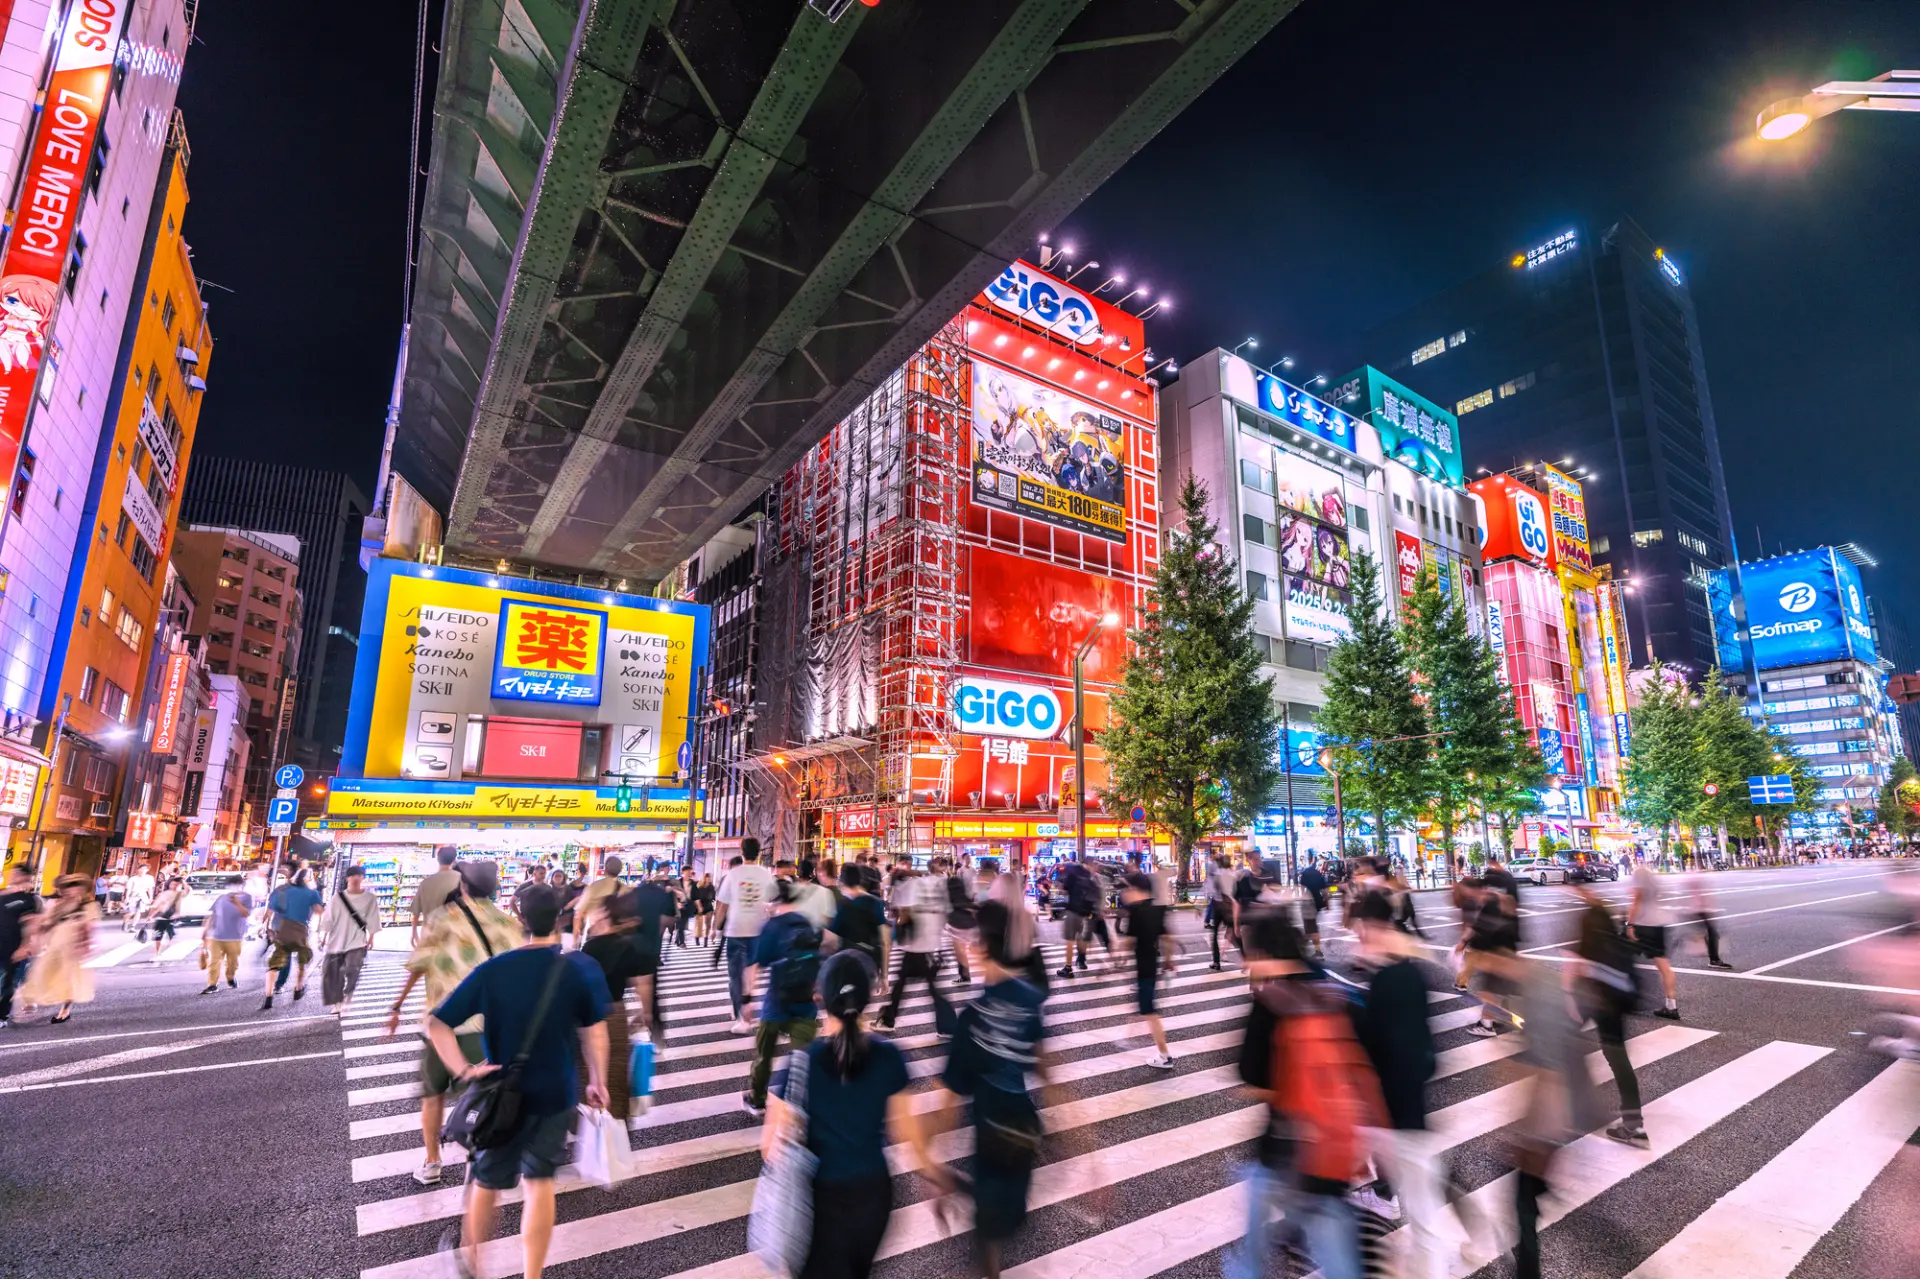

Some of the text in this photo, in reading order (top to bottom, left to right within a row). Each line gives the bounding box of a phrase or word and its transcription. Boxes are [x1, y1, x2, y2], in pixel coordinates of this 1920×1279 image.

[20, 88, 93, 258] LOVE MERCI
[398, 606, 489, 628] SHISEIDO
[1488, 604, 1503, 641] AKKY
[435, 628, 480, 644] KOSÉ
[1750, 616, 1823, 640] Sofmap
[517, 610, 591, 670] 薬
[613, 632, 686, 651] SHISEIDO
[404, 643, 475, 662] Kanebo
[643, 651, 678, 665] KOSÉ
[408, 662, 469, 679] SOFINA
[523, 669, 576, 682] DRUG STORE
[619, 665, 676, 681] Kanebo
[500, 676, 595, 699] マツモトキヨシ
[622, 682, 671, 697] SOFINA
[160, 690, 177, 737] HARERUYA
[954, 684, 1056, 731] GiGO
[155, 737, 169, 750] 2
[194, 729, 208, 764] mouse
[519, 744, 547, 757] SK-II
[980, 737, 1030, 766] 1号館
[280, 769, 294, 785] P
[276, 800, 293, 821] P
[352, 798, 473, 811] Matsumoto KiYoshi
[490, 792, 581, 813] マツモトキヨシ
[653, 804, 688, 814] KiYoshi
[848, 813, 871, 830] 宝くじ
[1037, 825, 1059, 835] GiGO
